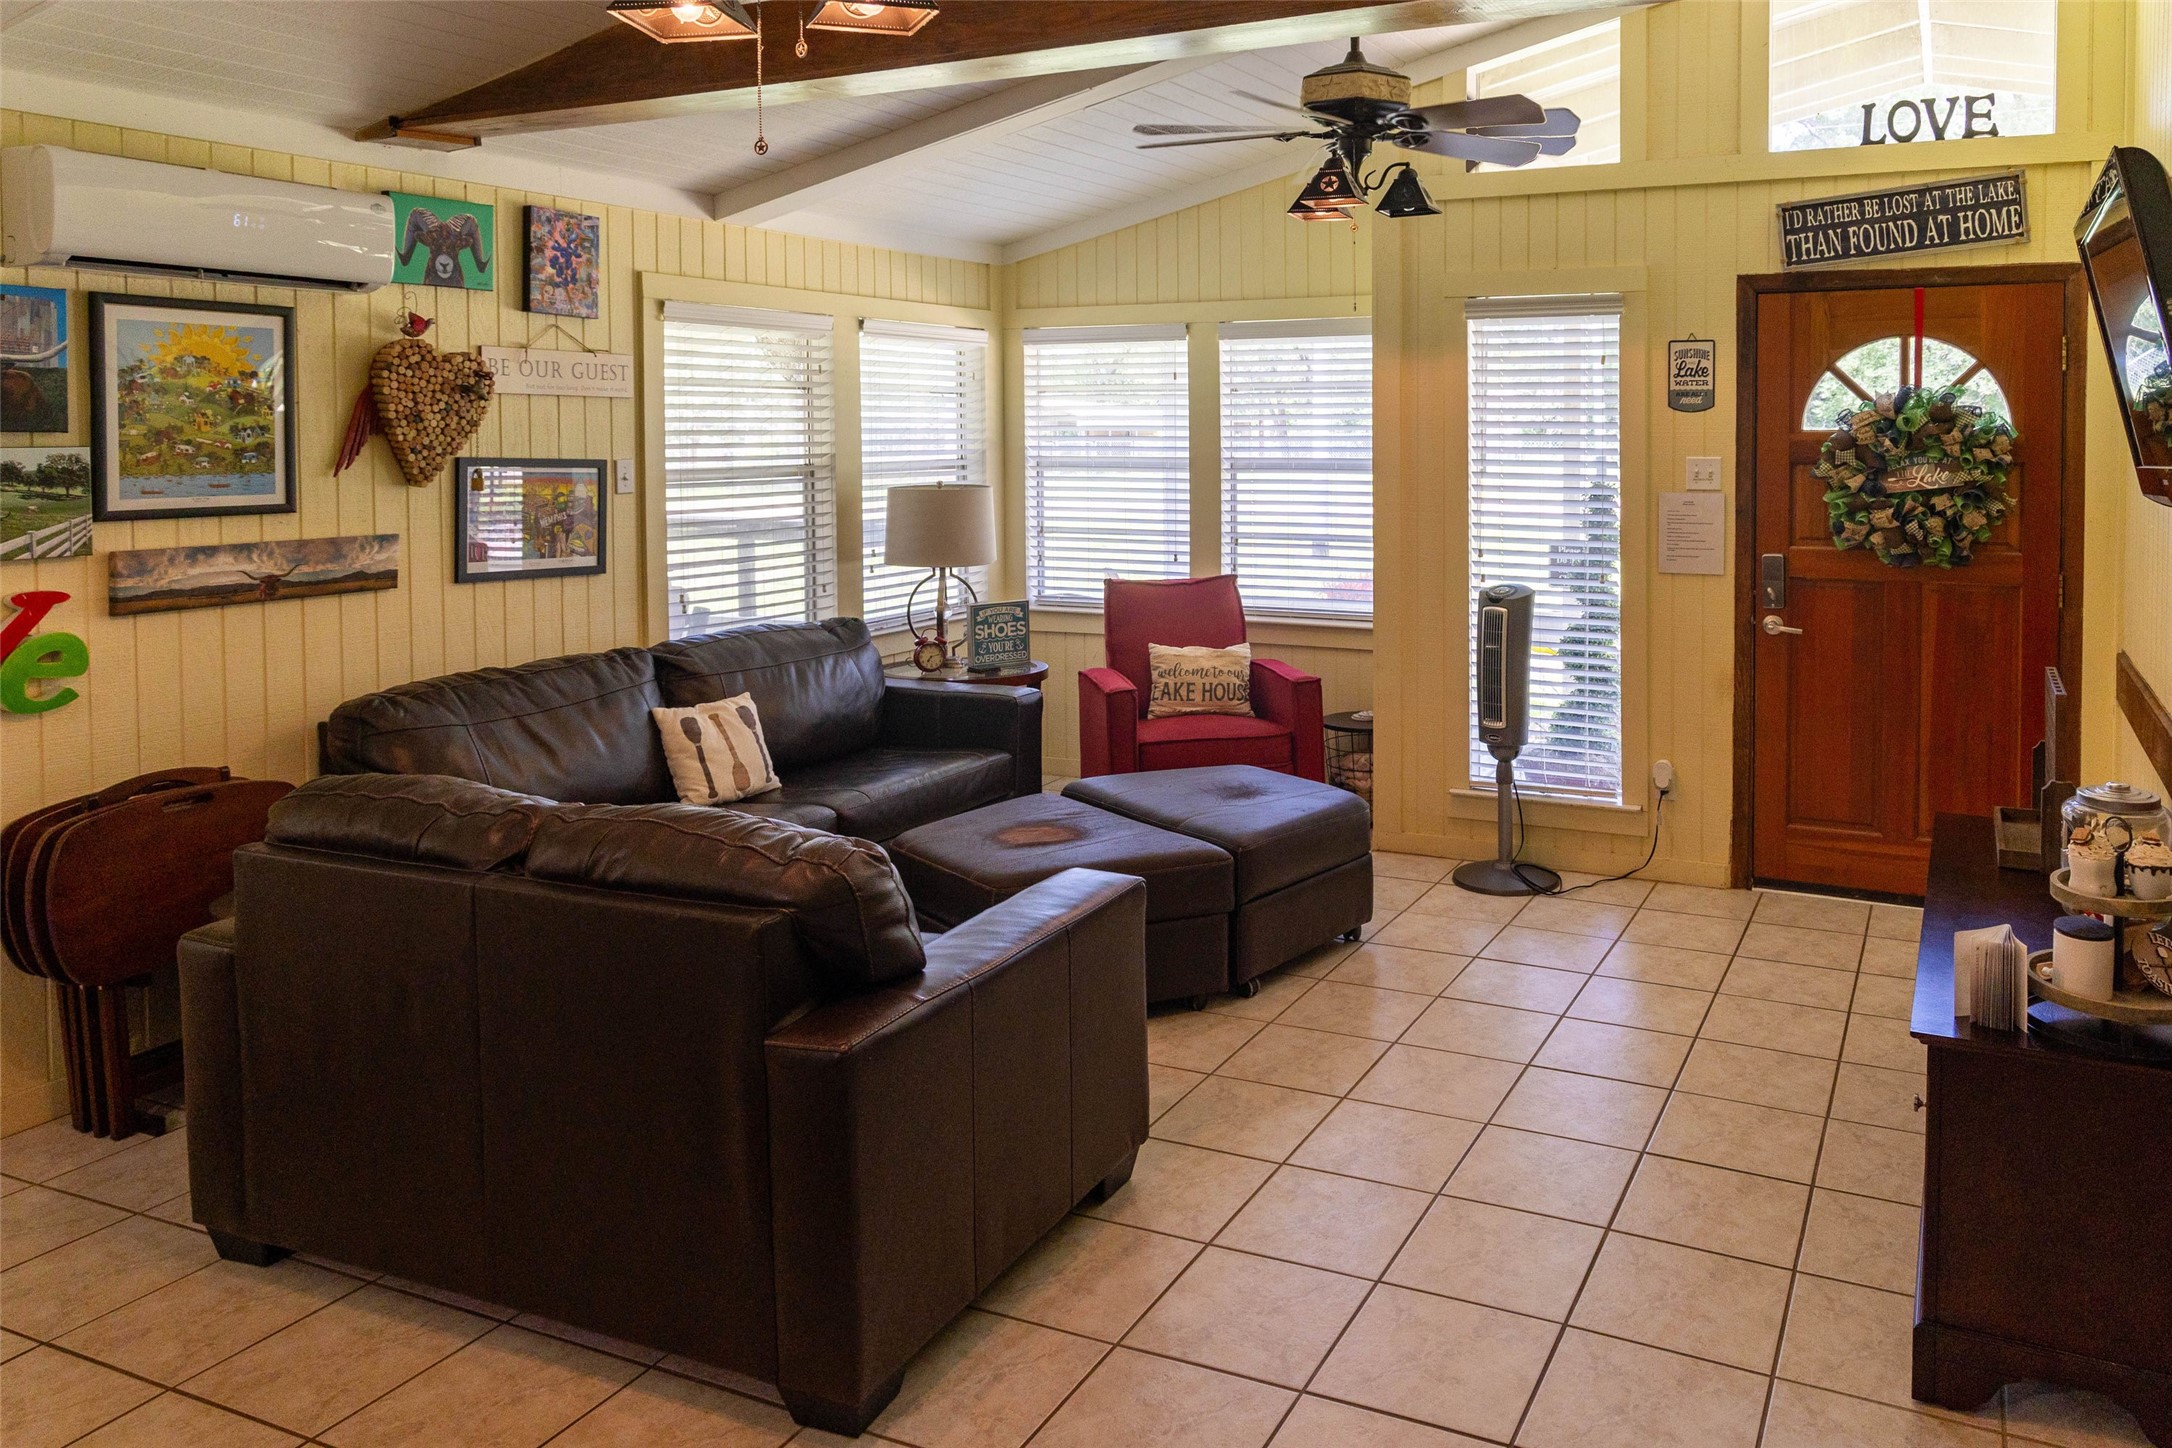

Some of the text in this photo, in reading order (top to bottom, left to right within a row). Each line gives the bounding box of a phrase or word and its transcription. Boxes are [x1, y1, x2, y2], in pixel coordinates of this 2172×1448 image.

[1860, 93, 1999, 145] LOVE
[1785, 180, 2020, 230] I'D RATHER BE LOST AT THE LAKE,
[1786, 205, 2023, 262] THAN FOUND AT HOME
[1674, 348, 1710, 361] SUNSHINE
[488, 357, 629, 382] BE OUR GUEST
[1673, 360, 1710, 378] Lake
[1680, 395, 1703, 404] need
[1906, 463, 1951, 488] Lake
[987, 613, 1013, 623] WEARING
[975, 621, 1026, 640] SHOES
[975, 651, 1027, 663] OVERDRESSED
[1157, 662, 1210, 679] welcome
